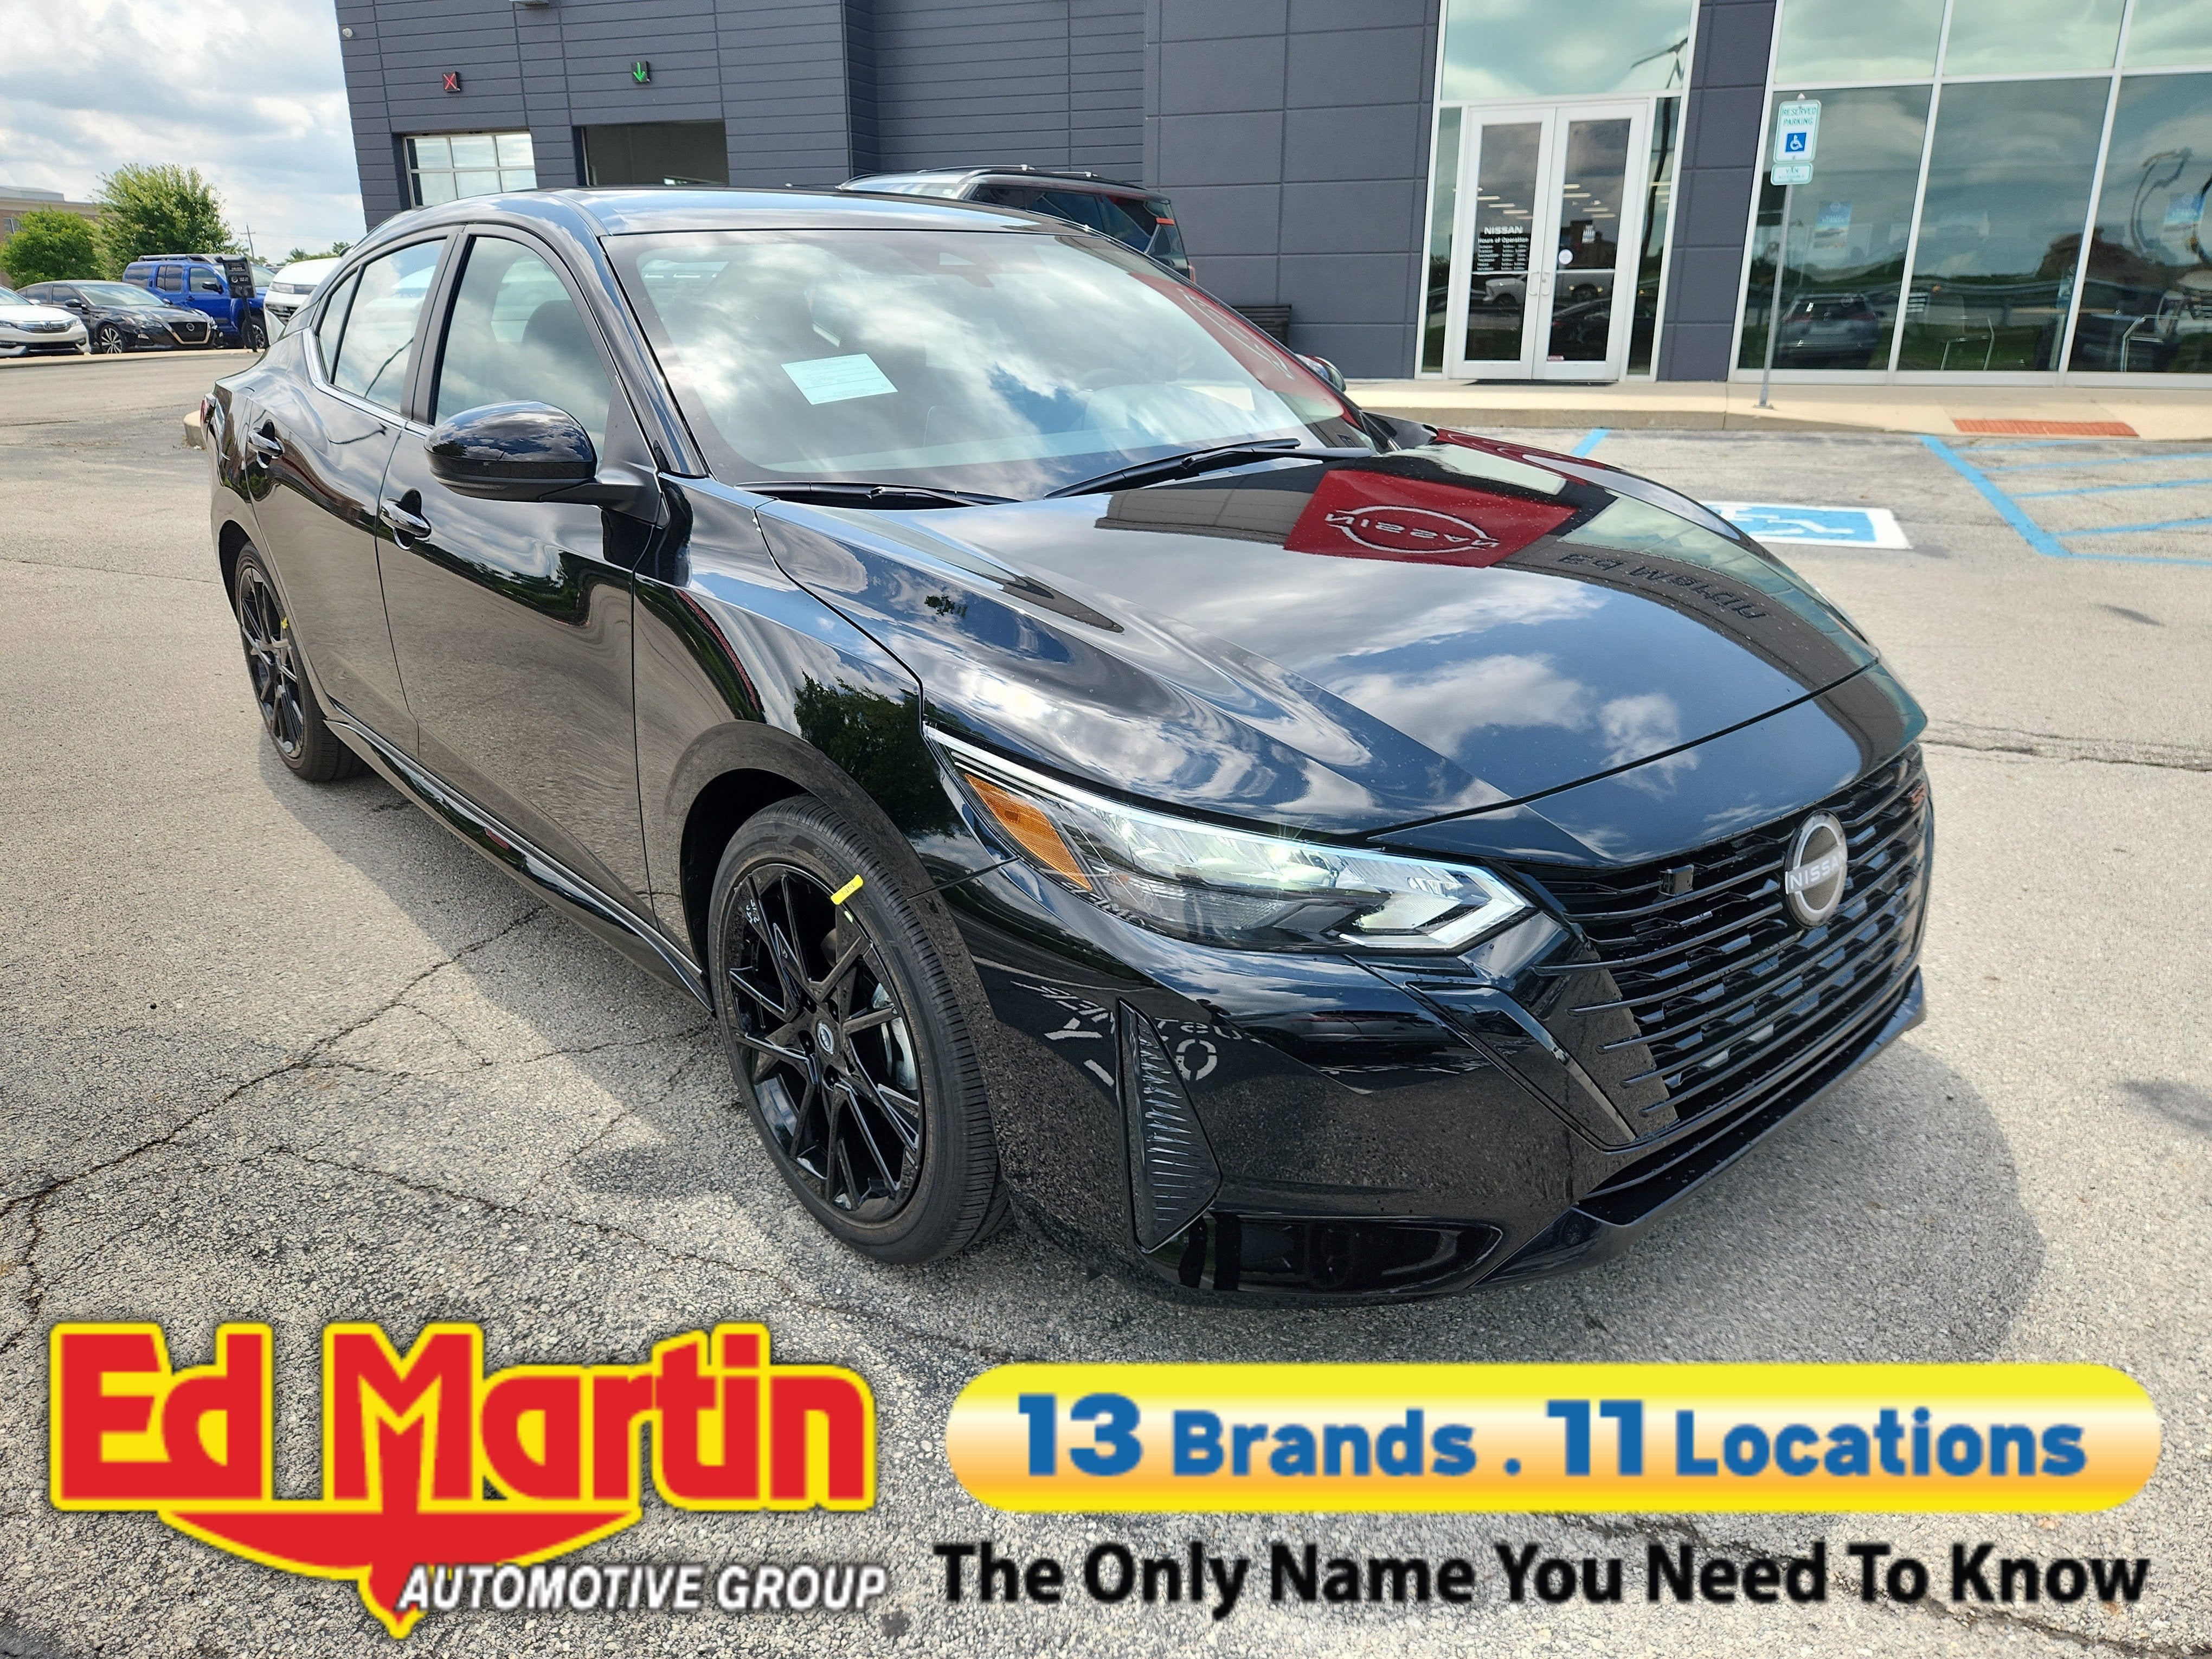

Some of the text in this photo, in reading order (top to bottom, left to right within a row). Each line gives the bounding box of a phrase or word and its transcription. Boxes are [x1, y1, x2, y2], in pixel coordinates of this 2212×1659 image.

[1782, 107, 1816, 115] RESERVED
[1484, 226, 1523, 234] NISSAN
[1790, 850, 1846, 890] NISSAN
